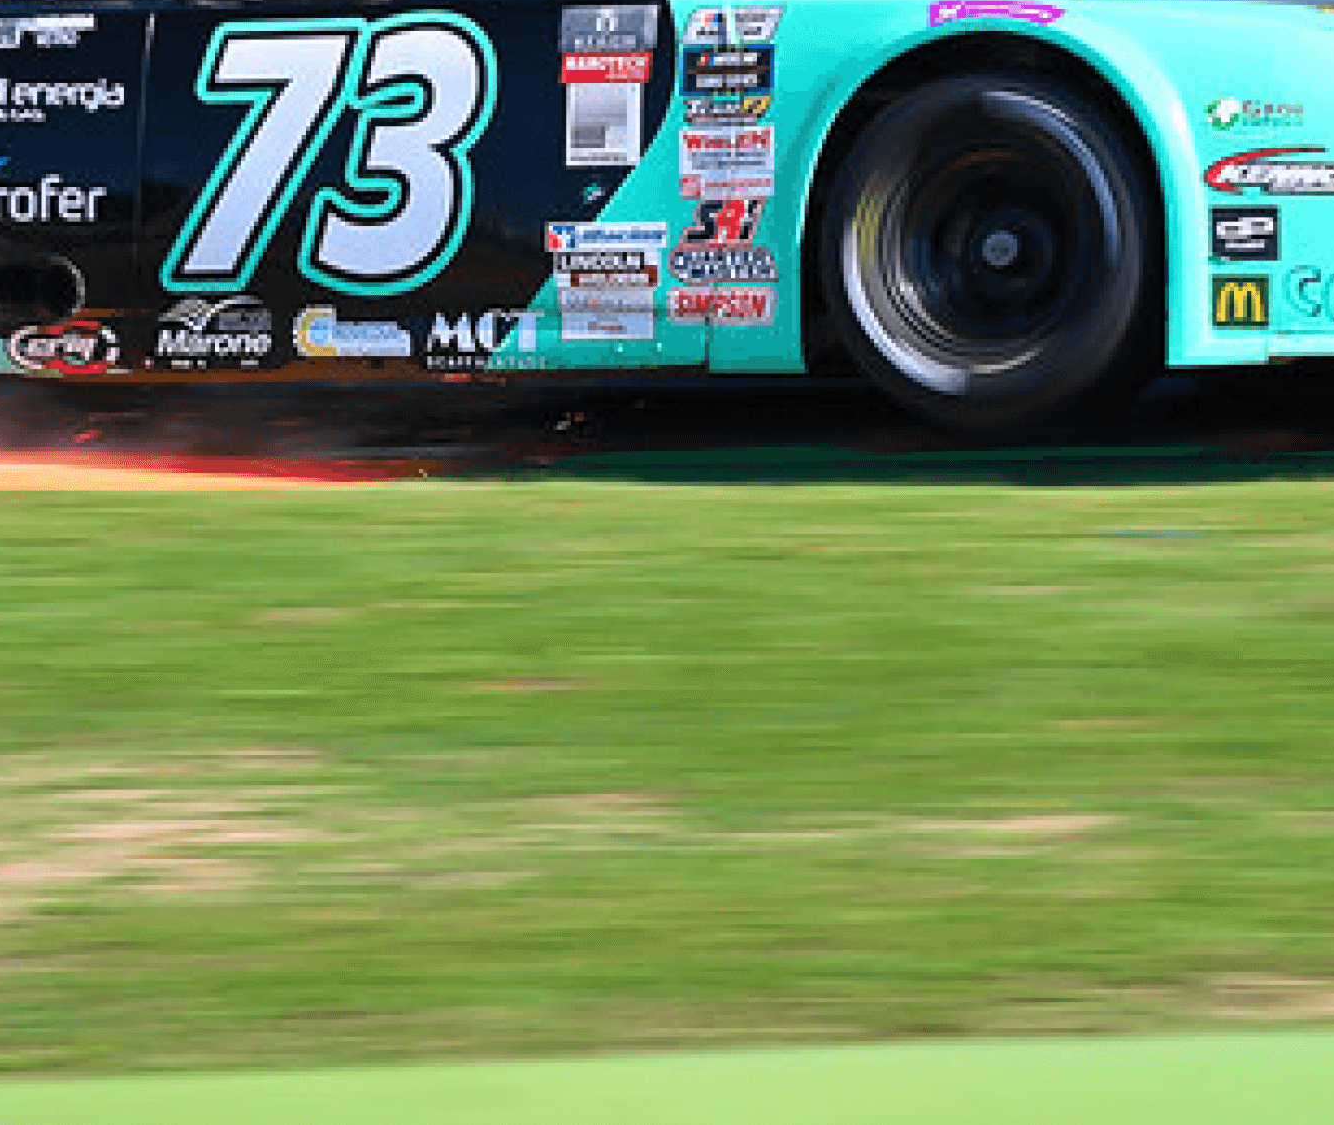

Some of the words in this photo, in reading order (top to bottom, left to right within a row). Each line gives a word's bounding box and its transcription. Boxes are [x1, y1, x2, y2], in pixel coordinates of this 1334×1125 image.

[163, 13, 495, 293] 73
[156, 329, 273, 356] Marone
[426, 308, 546, 353] MCT
